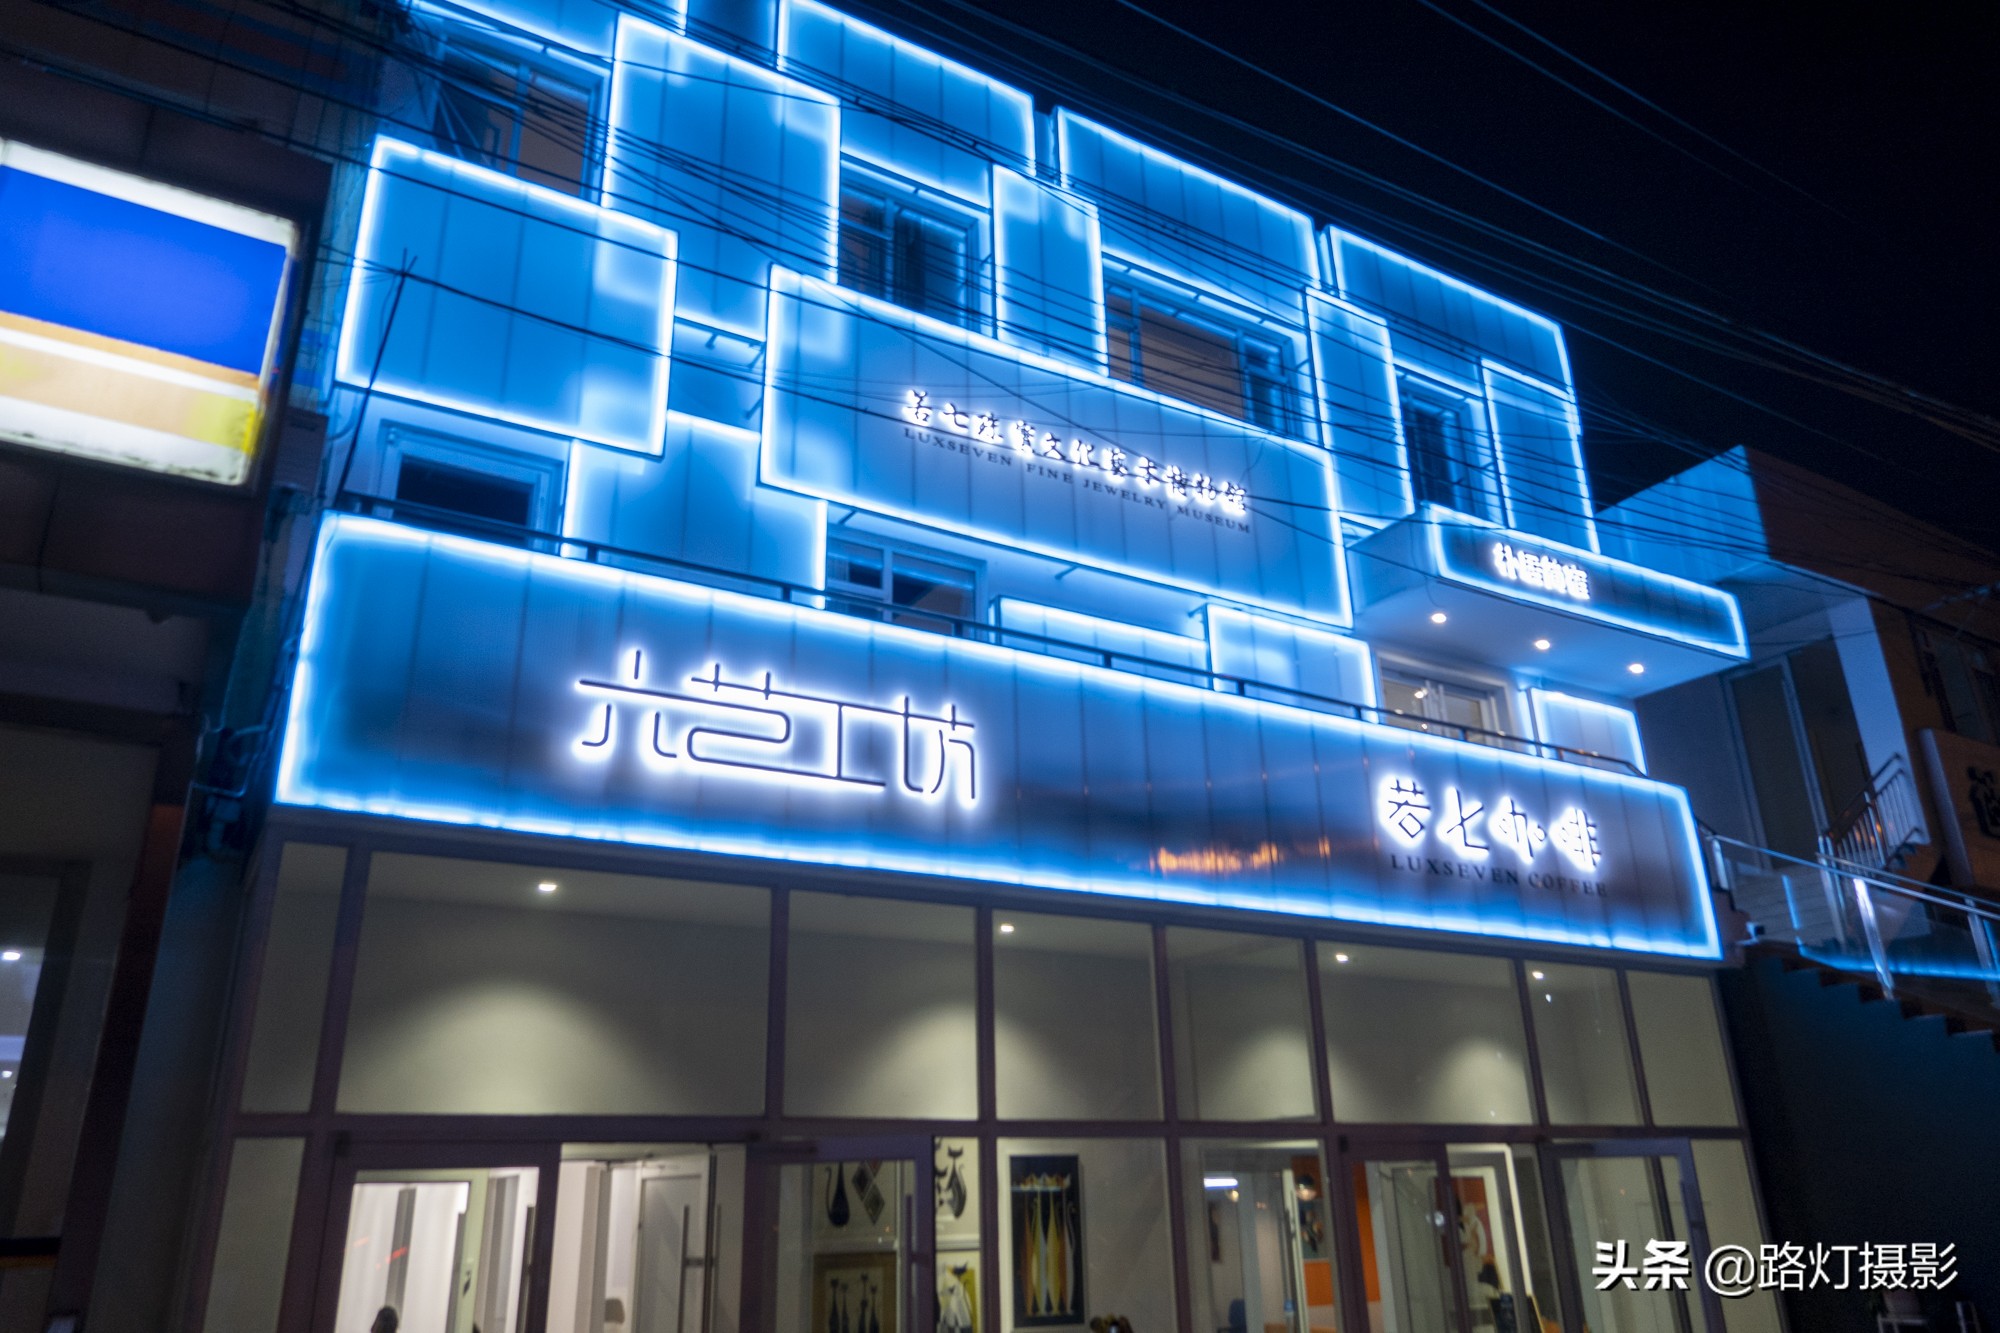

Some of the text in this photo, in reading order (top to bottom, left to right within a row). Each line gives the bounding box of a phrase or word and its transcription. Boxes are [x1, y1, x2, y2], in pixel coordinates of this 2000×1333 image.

[903, 427, 1251, 534] LUXSEVEN FINE JEWELRY MUSEUM
[1382, 777, 1603, 870] 若七咖啡
[1391, 854, 1608, 898] LUXSEVEN COFFEE
